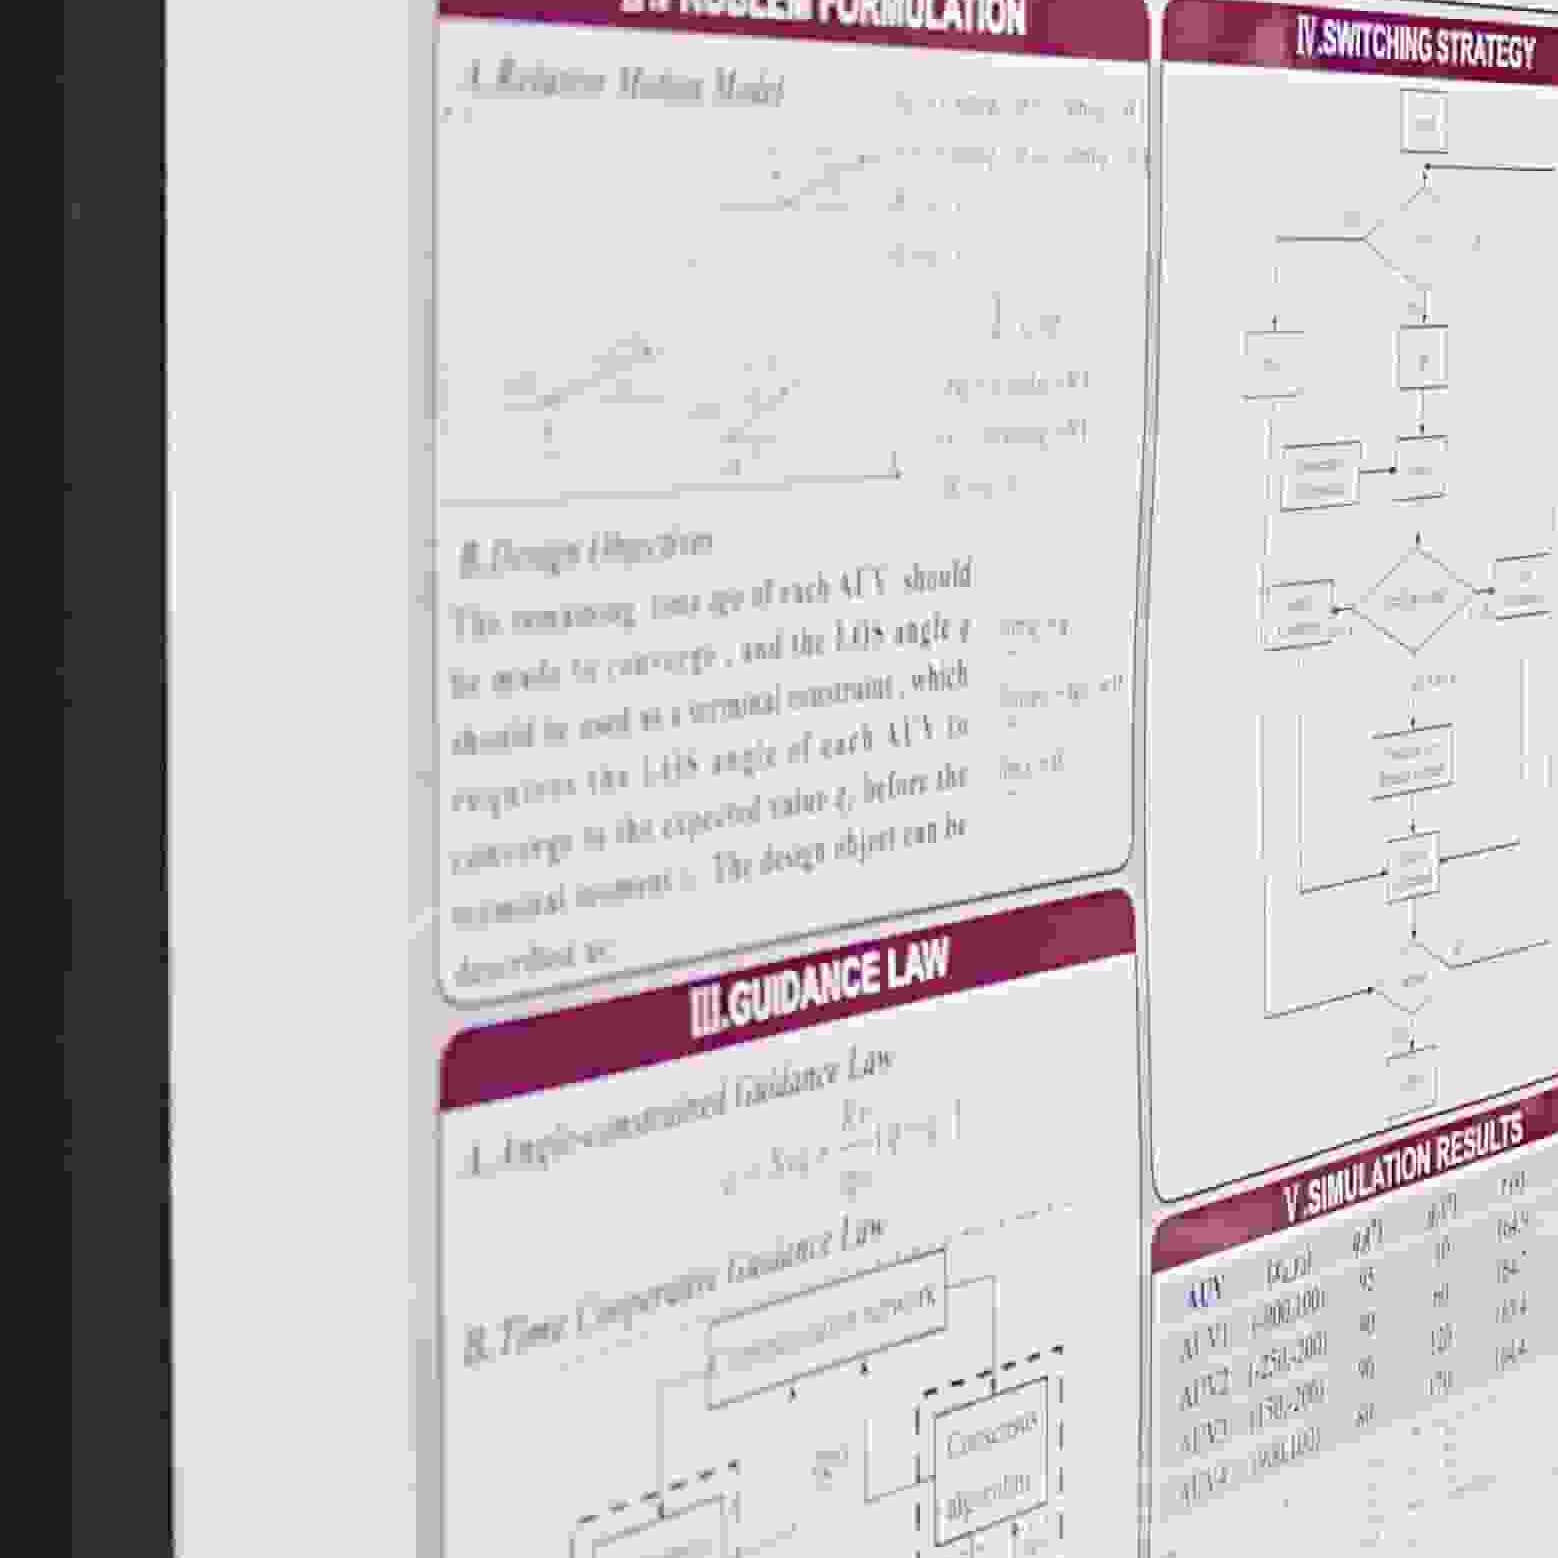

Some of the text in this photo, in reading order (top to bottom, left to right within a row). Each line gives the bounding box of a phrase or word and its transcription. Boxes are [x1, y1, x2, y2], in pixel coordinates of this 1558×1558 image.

[1435, 28, 1536, 69] STRATEGY
[885, 937, 950, 989] LAW
[1435, 1110, 1524, 1176] RESULTS
